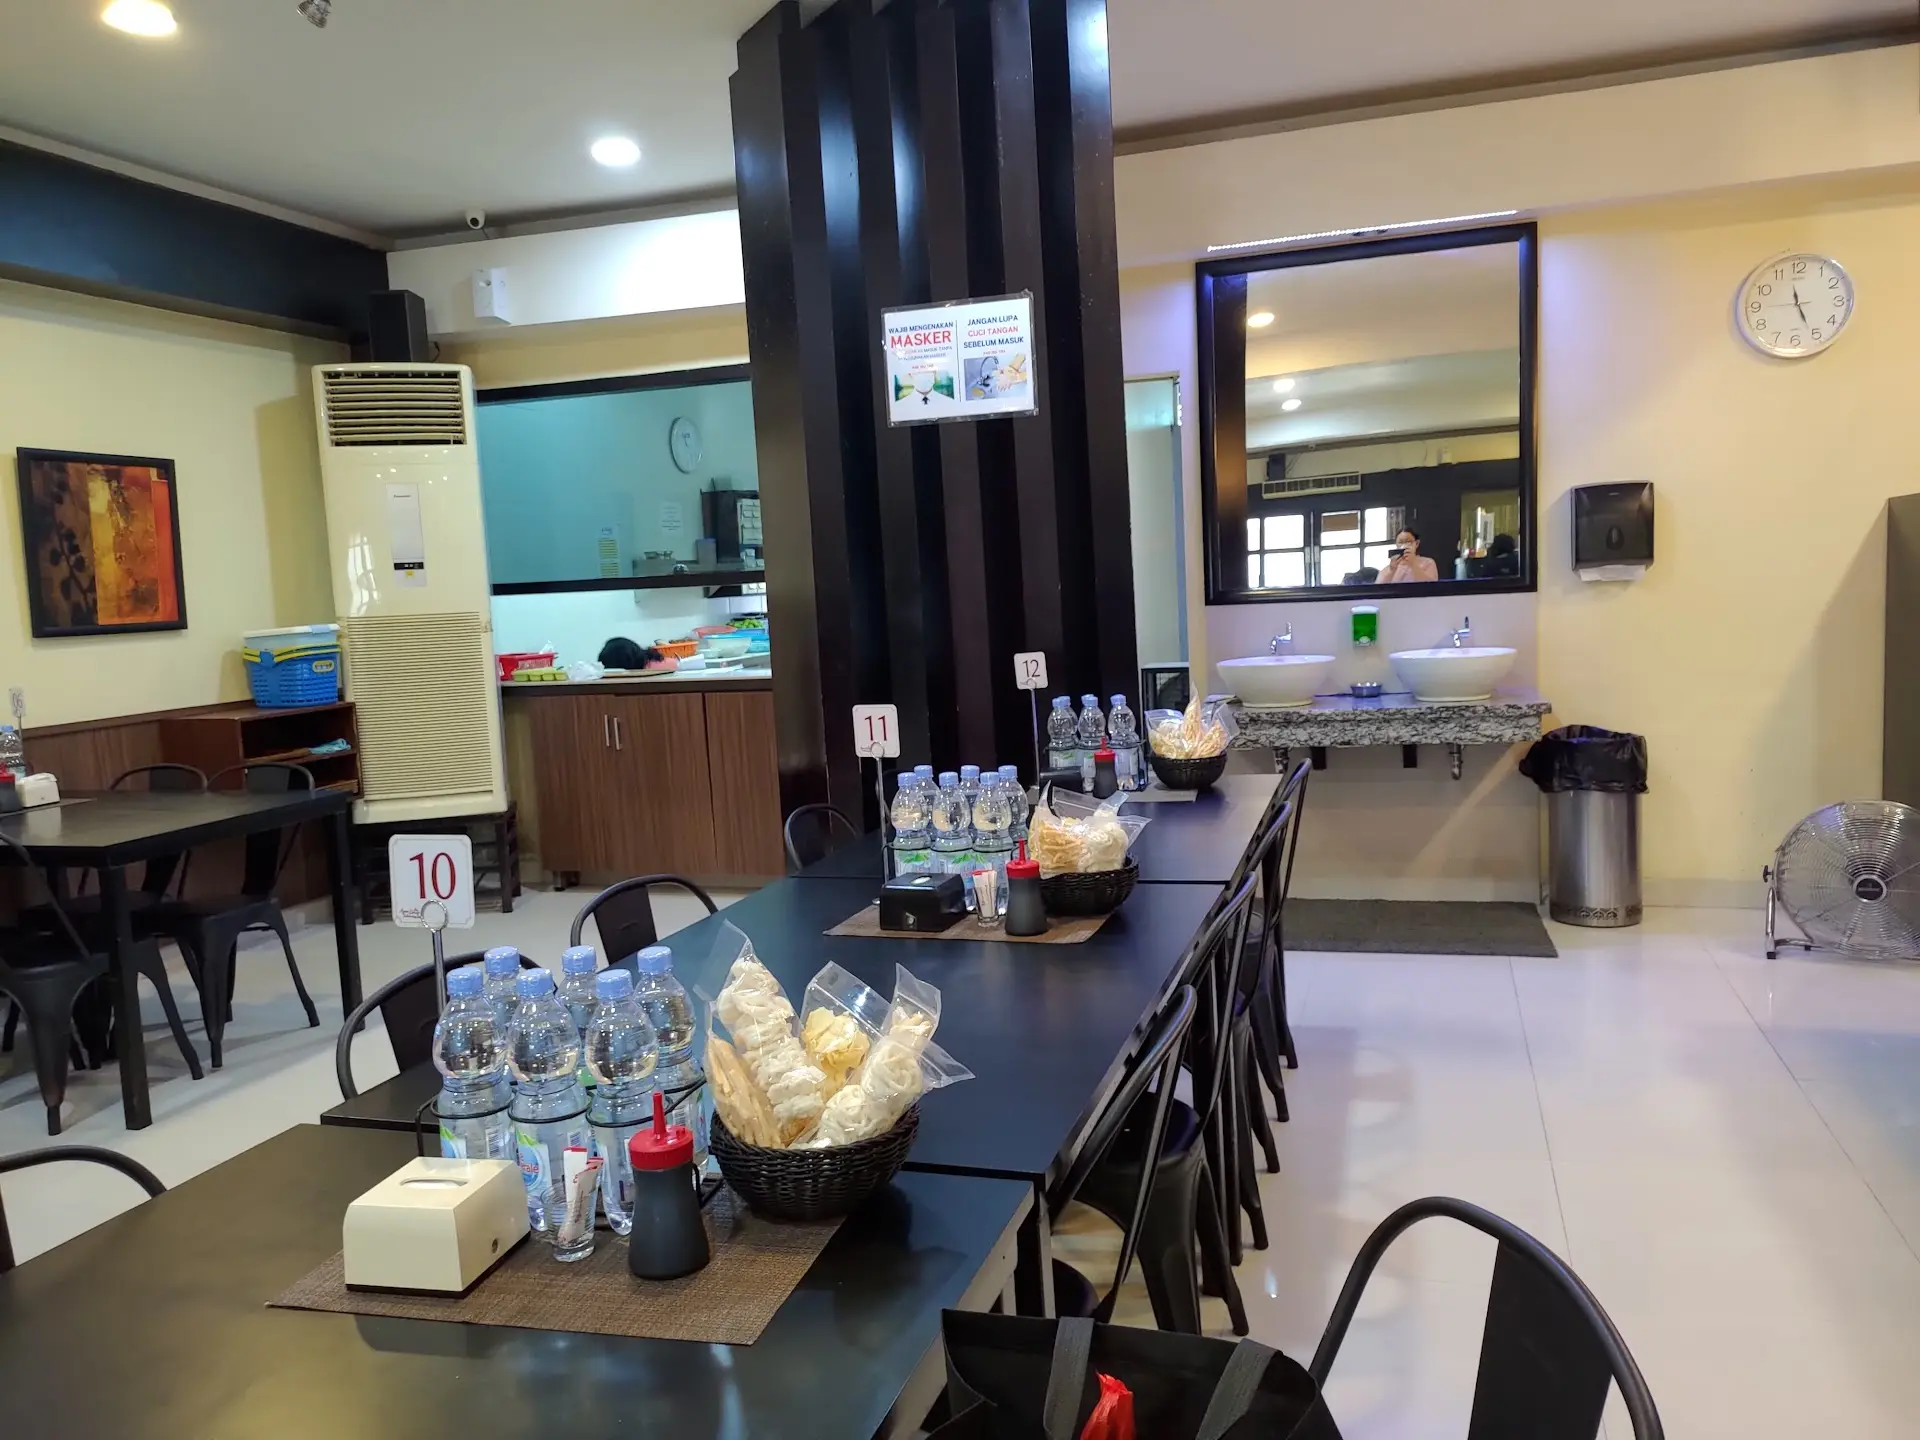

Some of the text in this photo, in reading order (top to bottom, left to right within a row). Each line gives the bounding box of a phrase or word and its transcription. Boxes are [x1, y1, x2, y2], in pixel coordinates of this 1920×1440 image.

[1775, 268, 1784, 281] 11
[1791, 262, 1807, 274] 12
[1819, 266, 1825, 277] 1
[1757, 284, 1772, 296] 10
[1828, 277, 1840, 290] 2
[1750, 301, 1762, 313] 9
[1833, 295, 1845, 307] 3
[967, 314, 1019, 326] JANGAN LUPA
[1755, 318, 1767, 331] 8
[1826, 314, 1837, 326] 4
[888, 321, 954, 334] WAJIB MENGENAKAN
[968, 325, 1019, 338] CUCI TANGAN
[890, 330, 952, 349] MASKER
[1772, 331, 1782, 344] 7
[1789, 334, 1802, 347] 6
[1811, 328, 1822, 341] 5
[963, 335, 1024, 349] SEBELUM MASUK
[1022, 659, 1041, 678] 12
[864, 714, 888, 742] 11
[409, 852, 457, 900] 10
